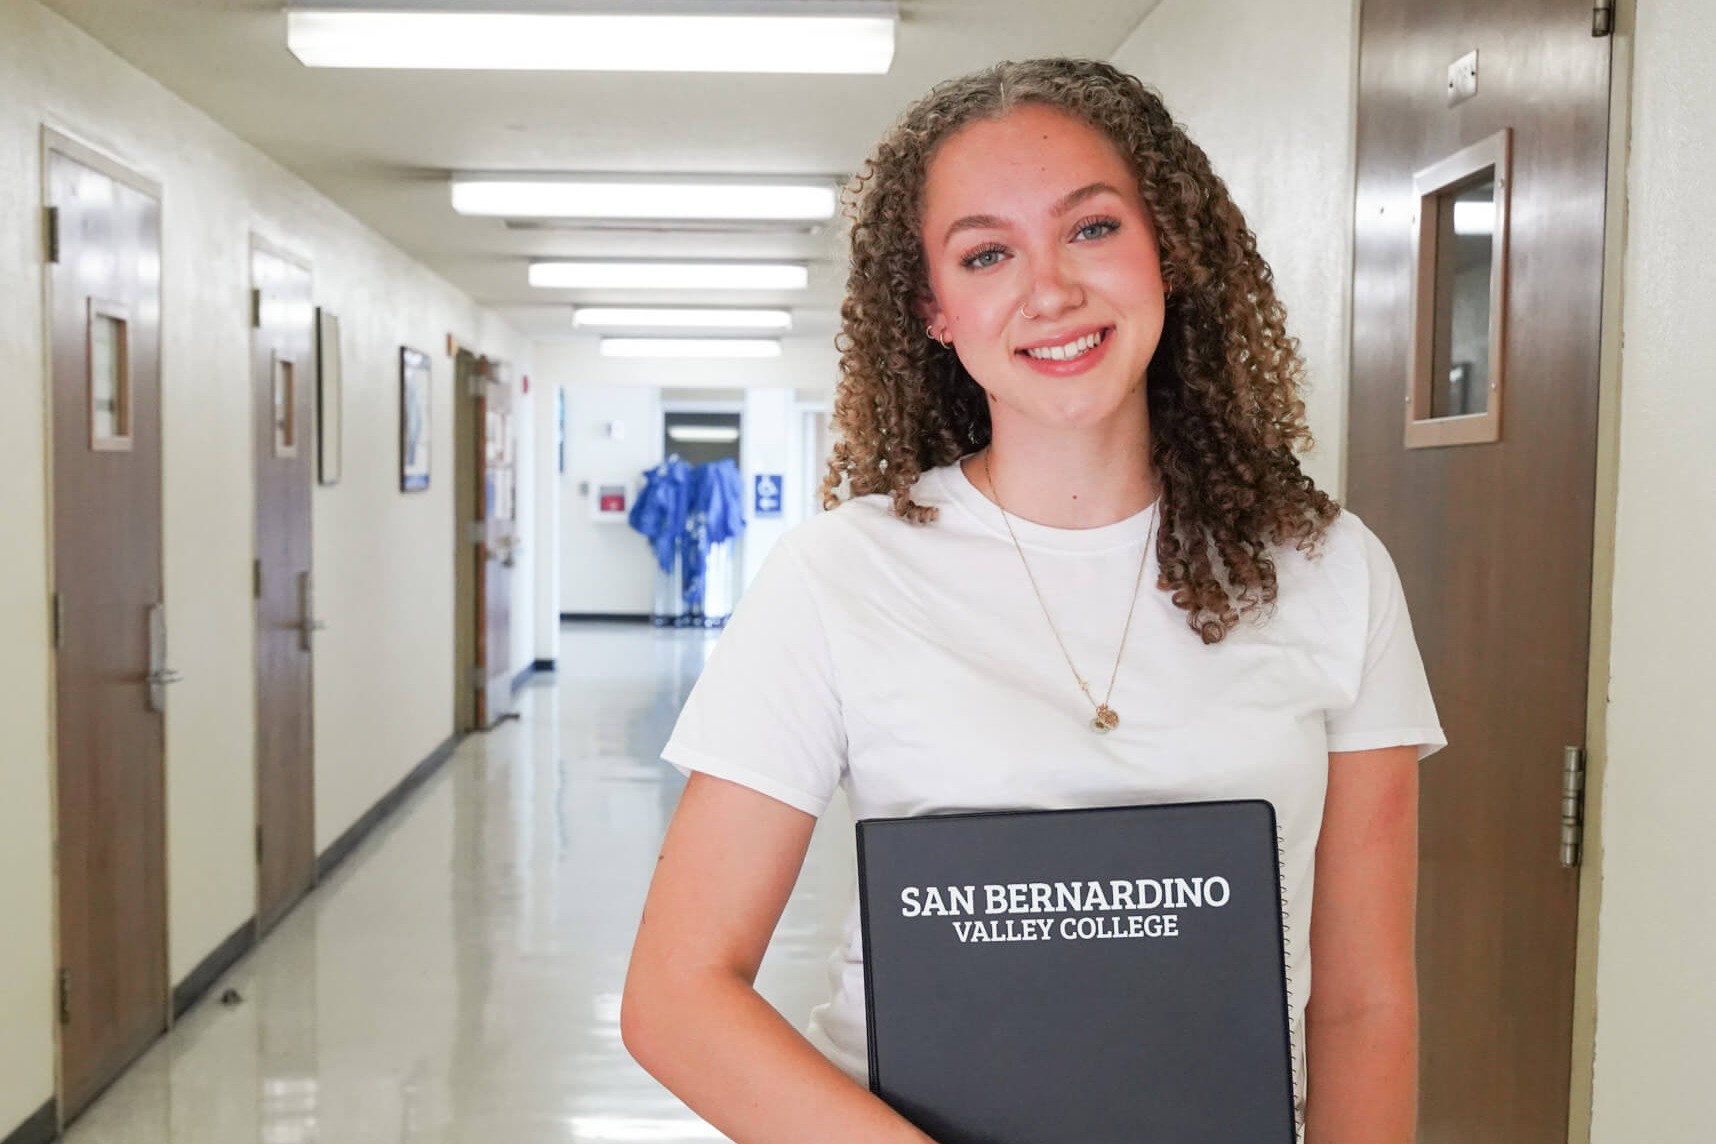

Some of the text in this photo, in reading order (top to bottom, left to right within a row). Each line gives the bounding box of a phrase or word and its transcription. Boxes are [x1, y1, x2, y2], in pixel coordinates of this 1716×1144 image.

[900, 876, 1231, 917] SAN BERNARDINO
[952, 915, 1179, 943] VALLEY COLLEGE
